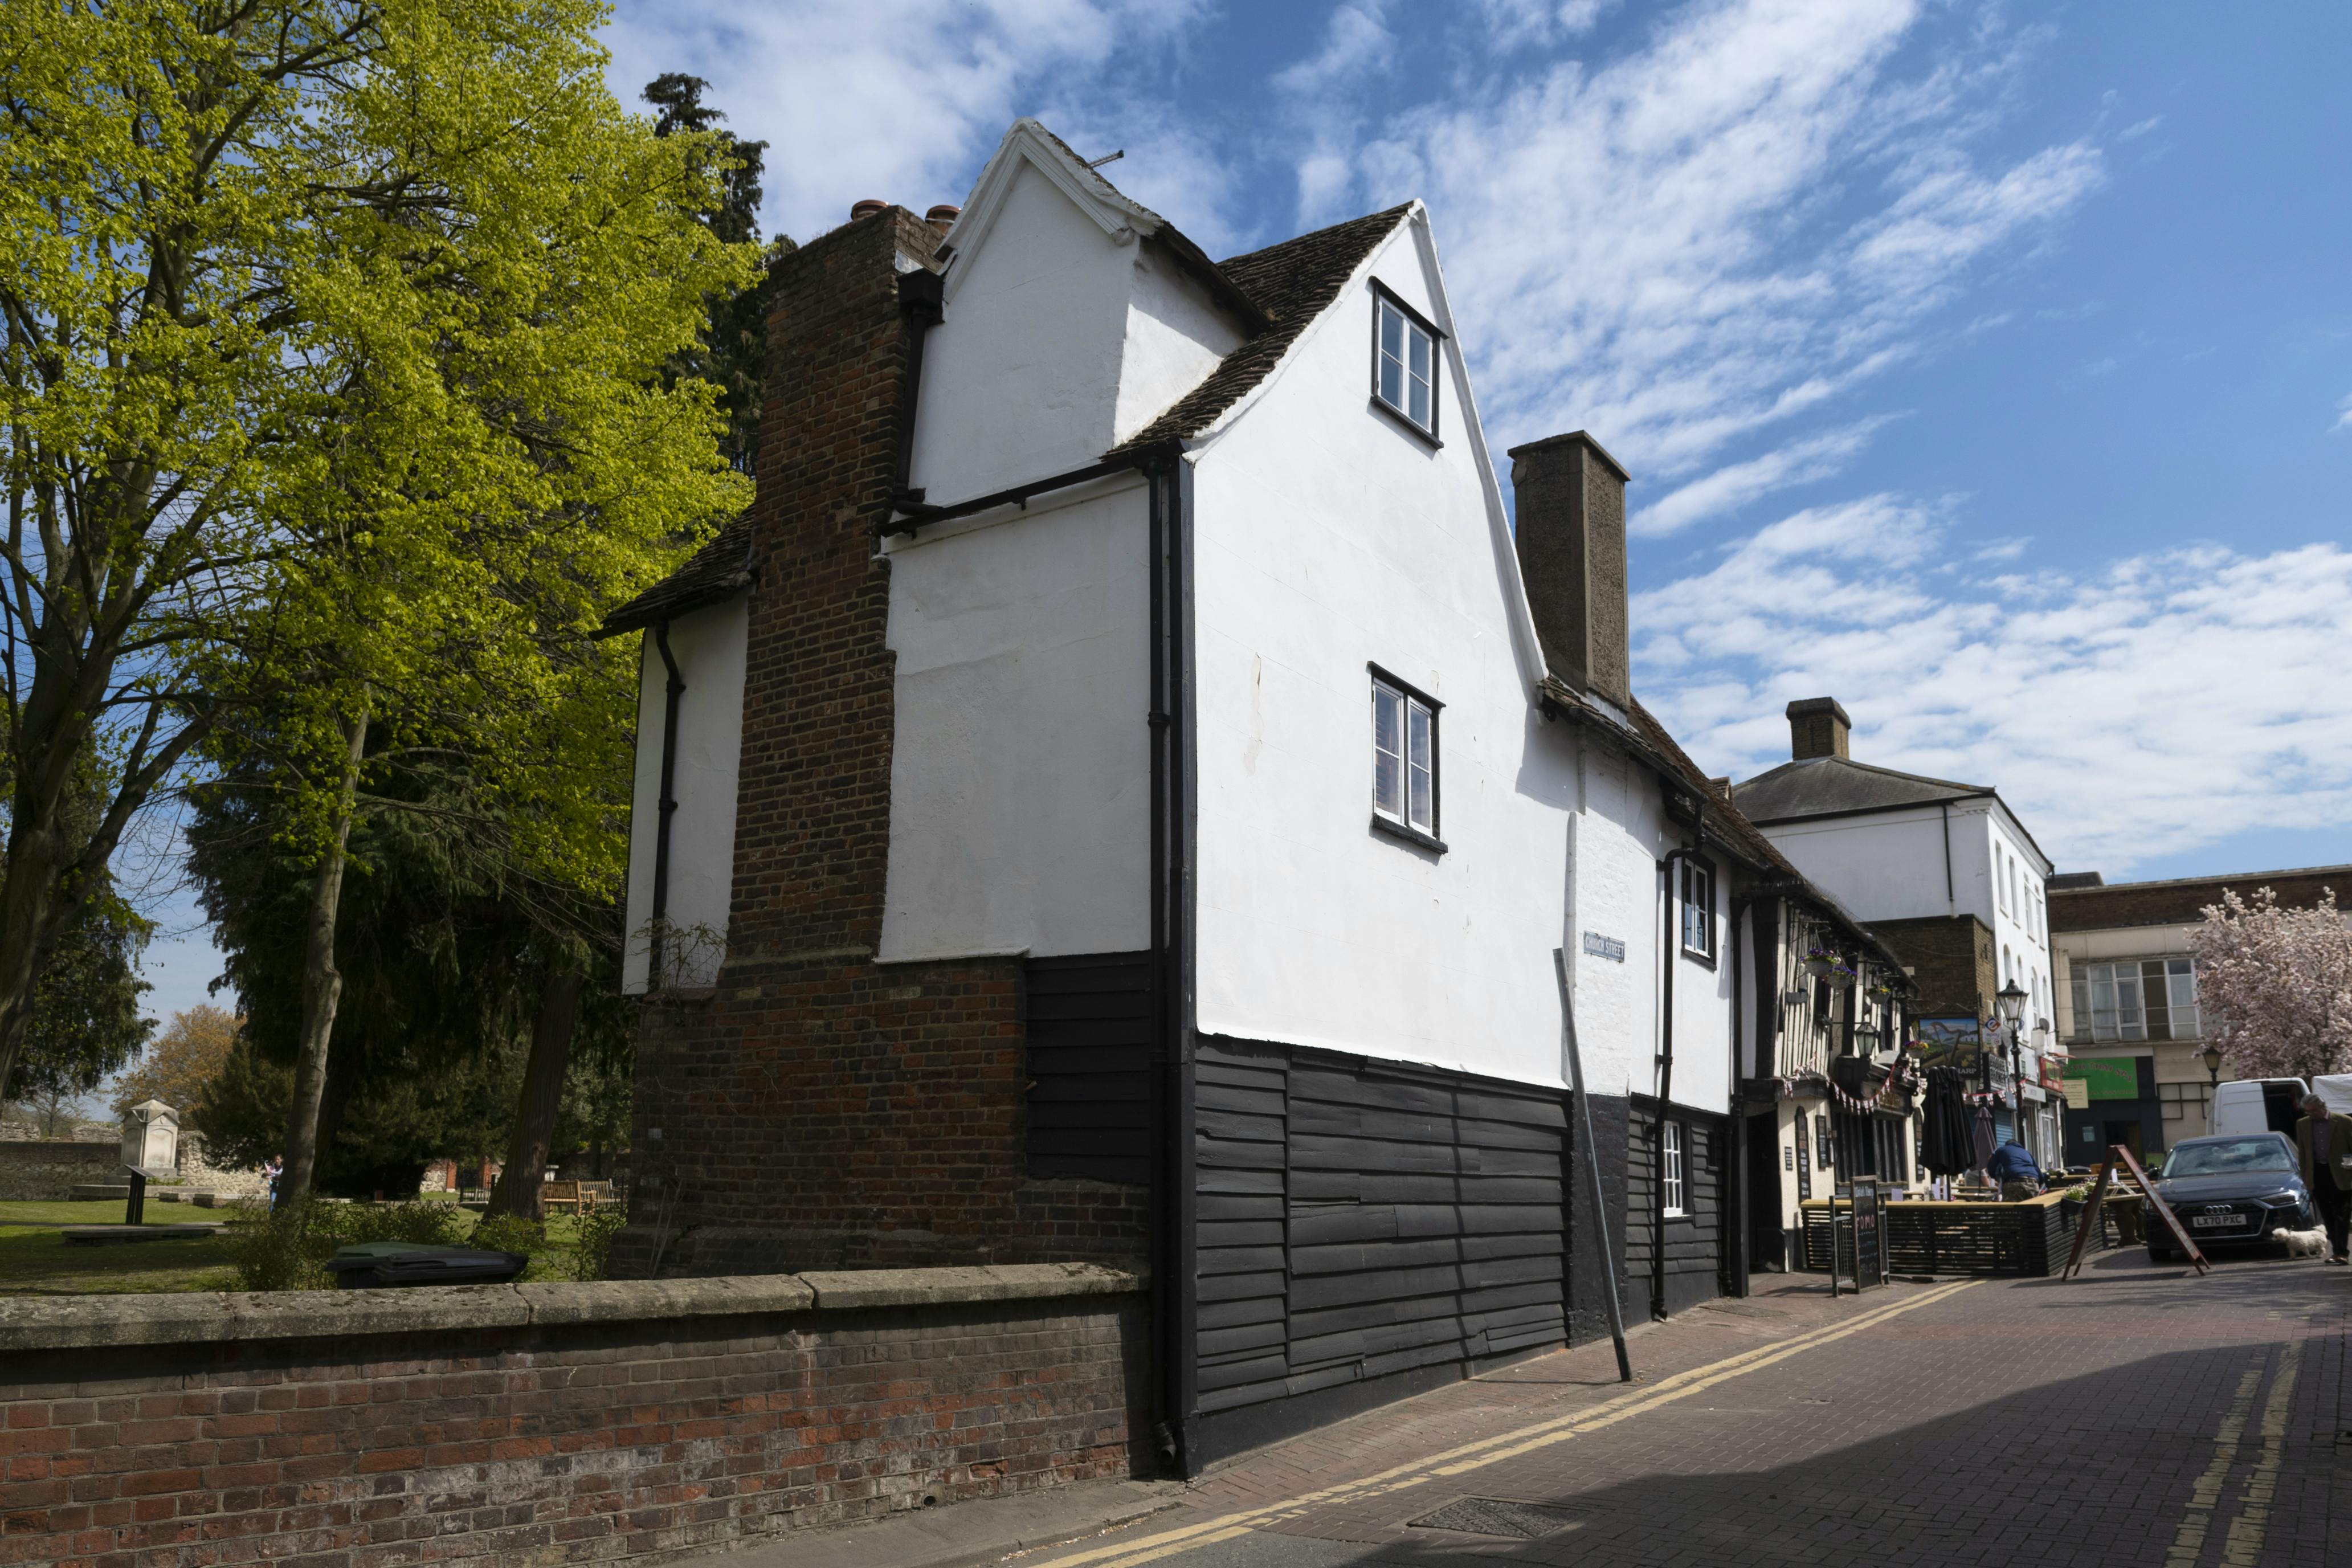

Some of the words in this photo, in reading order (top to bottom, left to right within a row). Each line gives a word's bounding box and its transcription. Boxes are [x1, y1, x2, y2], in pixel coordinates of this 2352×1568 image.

[1586, 936, 1604, 953] CHURCH
[1606, 941, 1624, 958] STREET
[2196, 1216, 2221, 1226] LX70
[2223, 1215, 2242, 1224] PXC
